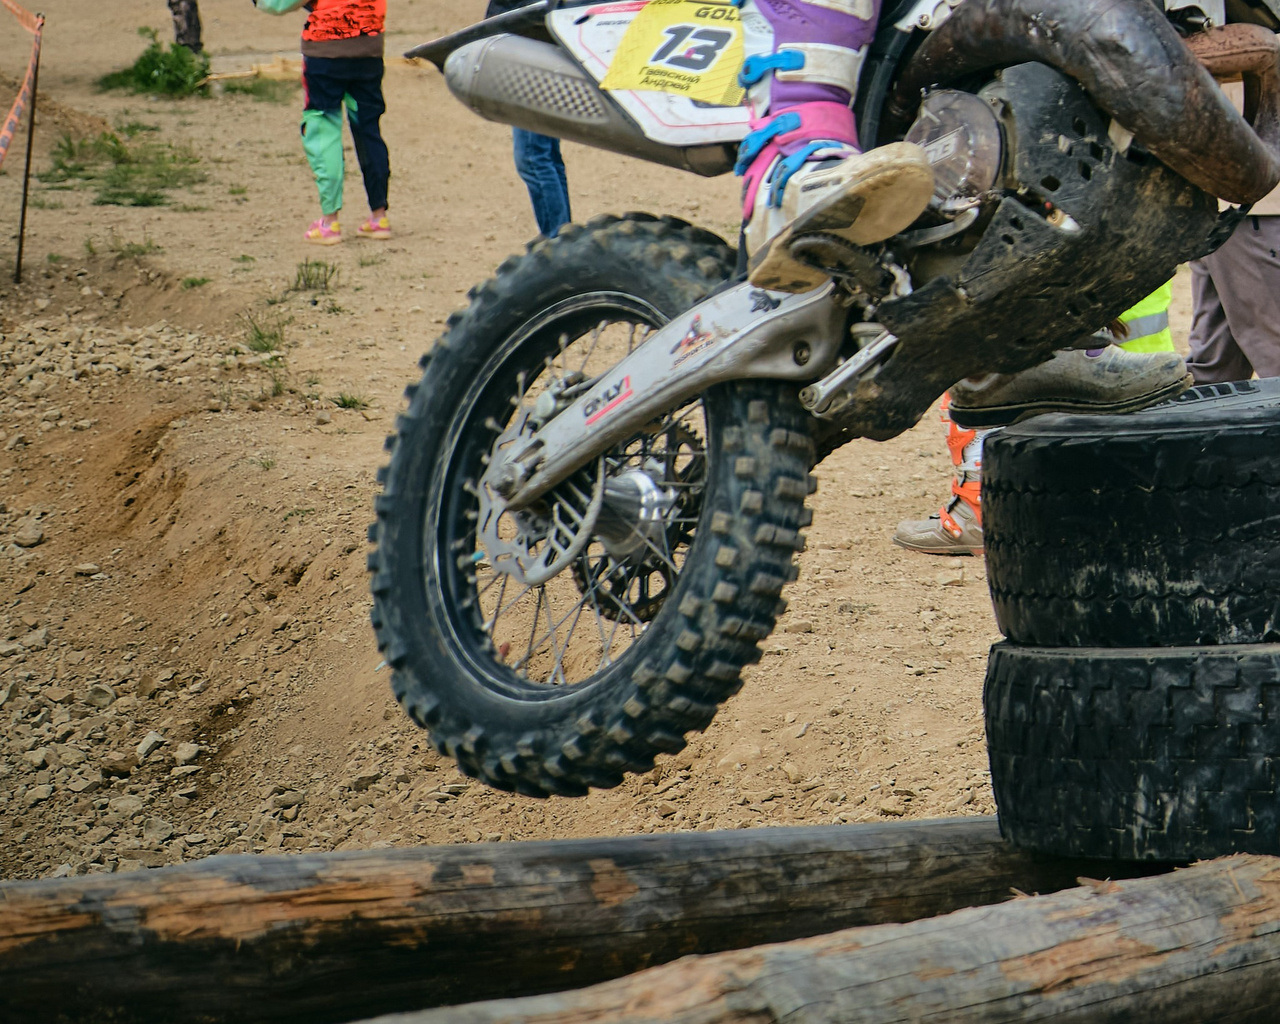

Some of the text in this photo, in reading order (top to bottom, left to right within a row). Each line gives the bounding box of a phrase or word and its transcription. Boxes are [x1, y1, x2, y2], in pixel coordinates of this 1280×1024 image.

[695, 6, 742, 22] GOL
[650, 25, 734, 71] 13
[639, 75, 691, 91] Андрей
